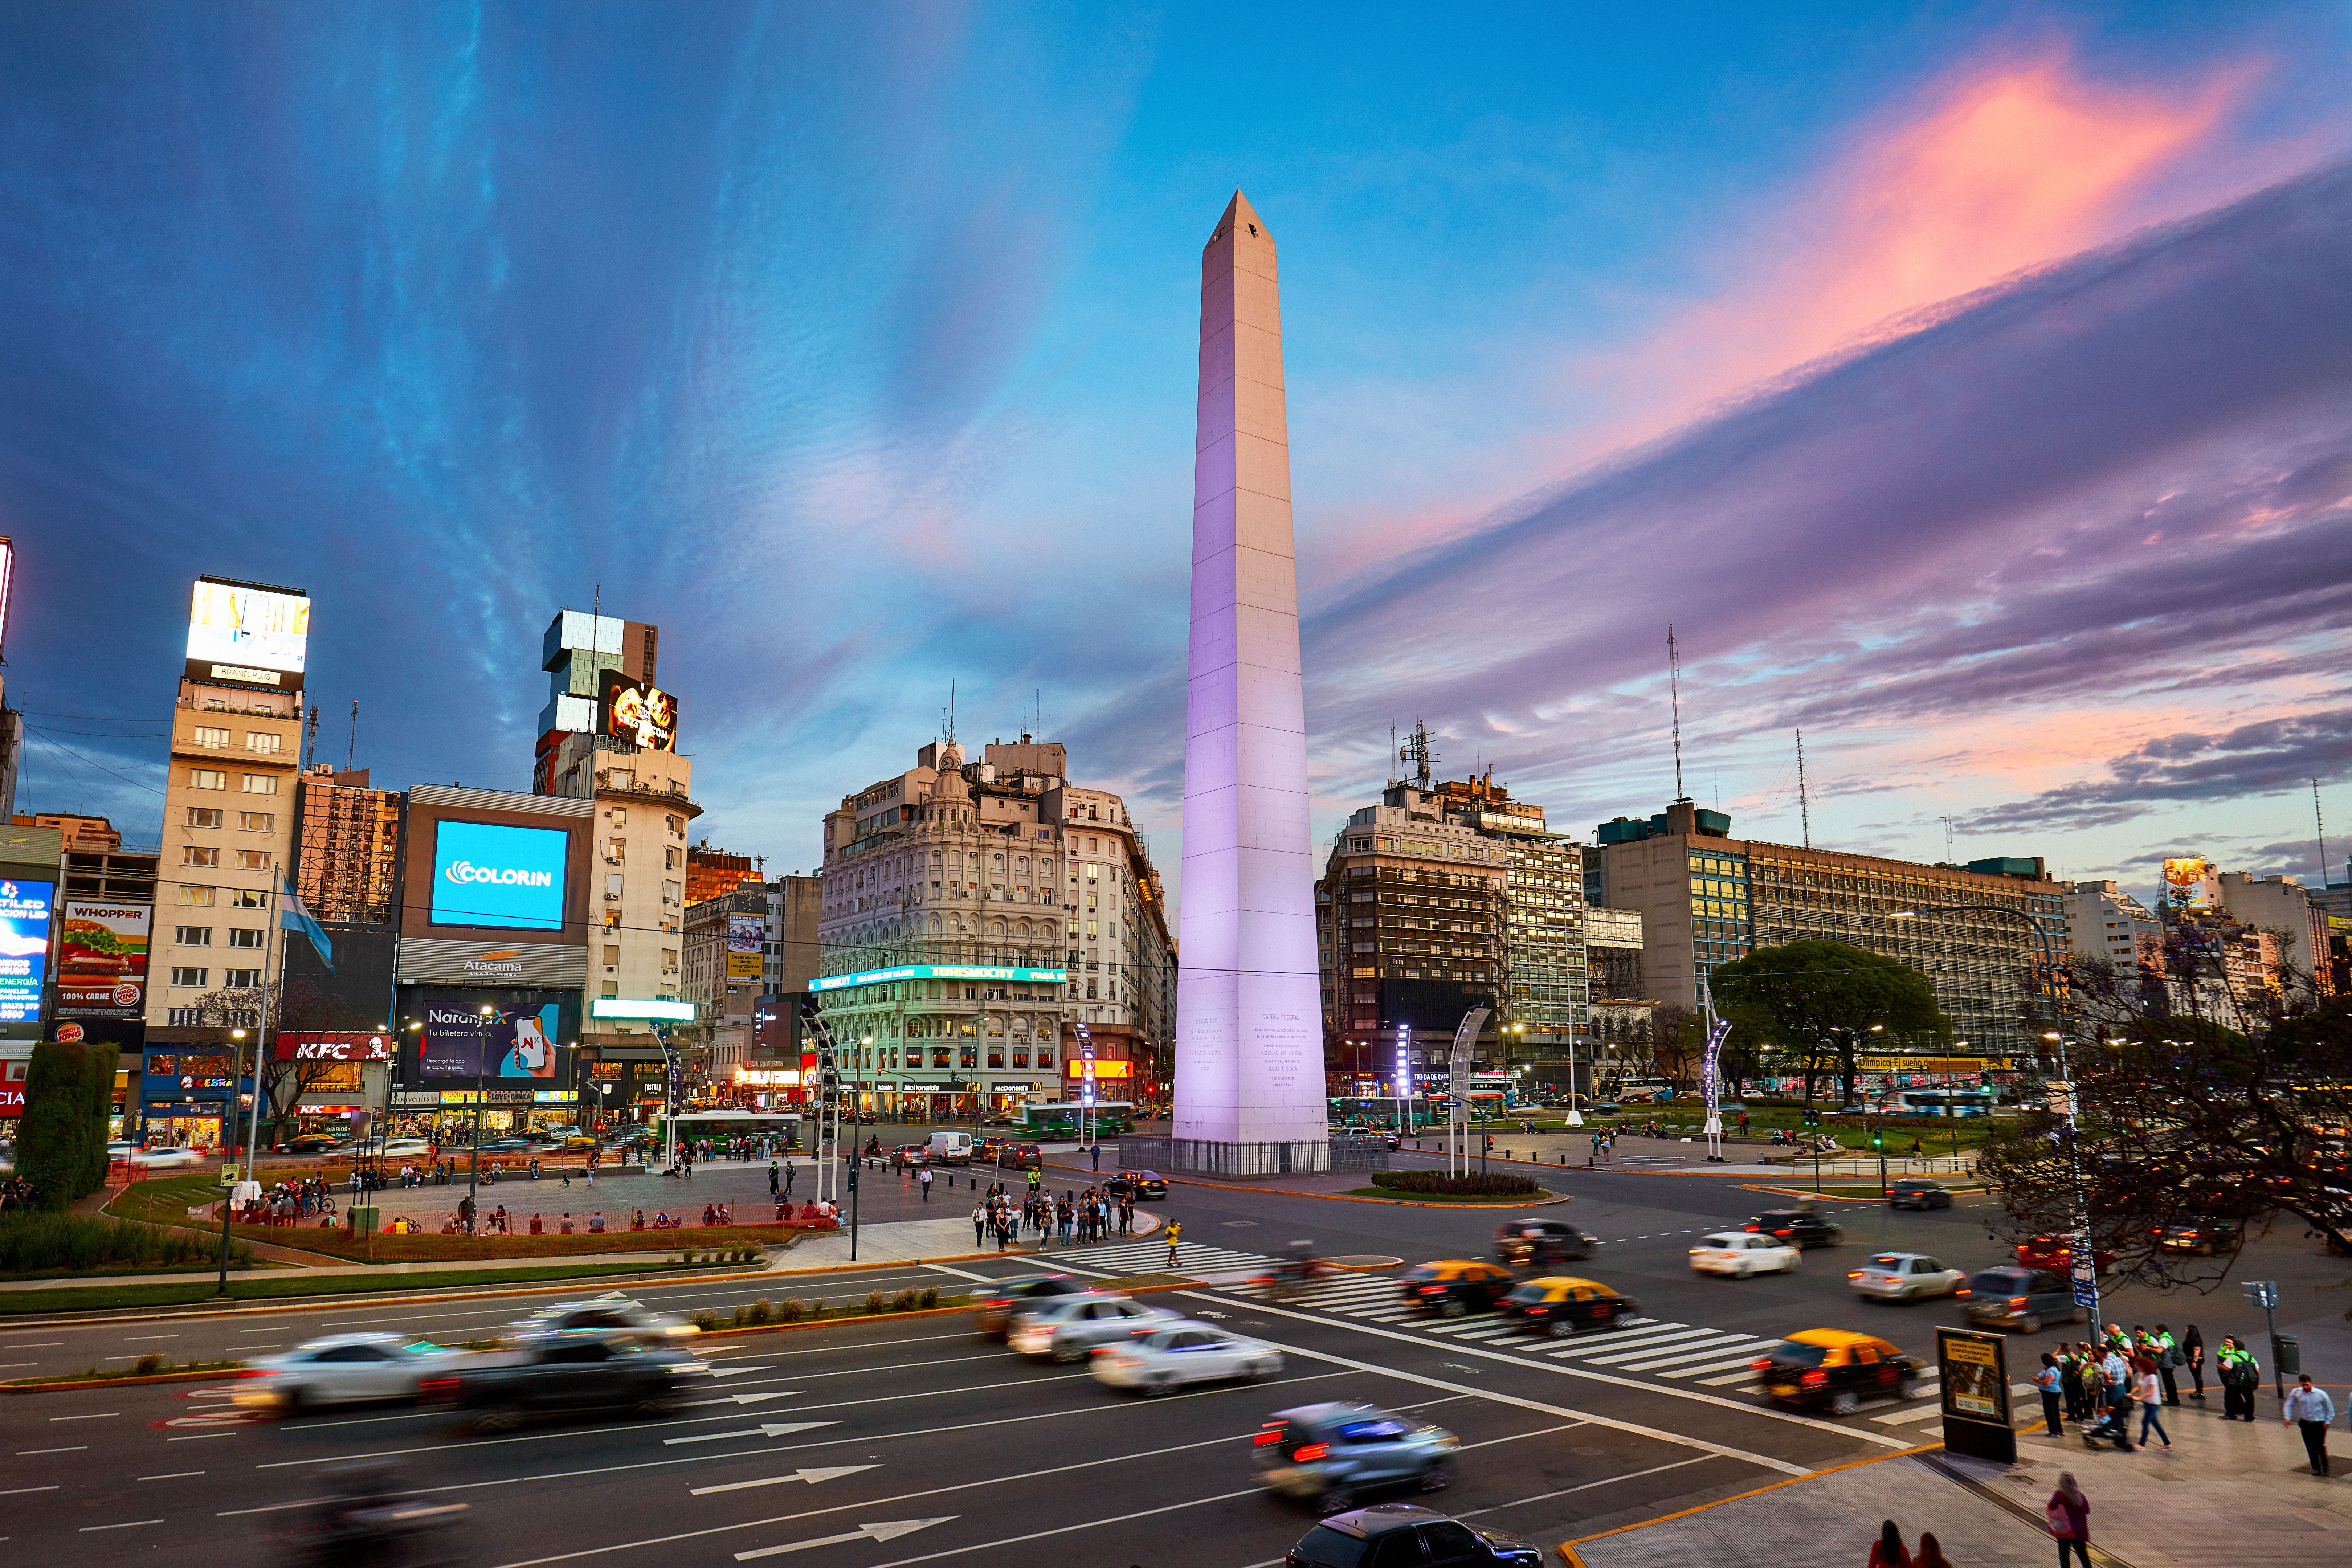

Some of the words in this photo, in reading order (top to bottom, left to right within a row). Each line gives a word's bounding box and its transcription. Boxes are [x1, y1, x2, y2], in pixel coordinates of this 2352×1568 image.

[222, 669, 250, 678] BRAND
[253, 672, 270, 681] PLUS
[0, 899, 45, 909] TILED
[29, 910, 48, 919] LED
[74, 907, 142, 919] WHOPPER
[464, 960, 522, 971] Atacama
[930, 967, 1015, 979] TURISMOCITY
[820, 976, 851, 989] TURISMOCITY
[117, 992, 137, 1001] KING
[429, 1010, 493, 1028] Naranja
[58, 1026, 81, 1036] BURGER
[58, 1031, 81, 1042] KING
[296, 1044, 351, 1059] KFC
[1903, 1058, 1922, 1067] sueño
[645, 1083, 661, 1092] TOSTADO
[1951, 1348, 1990, 1357] transformando
